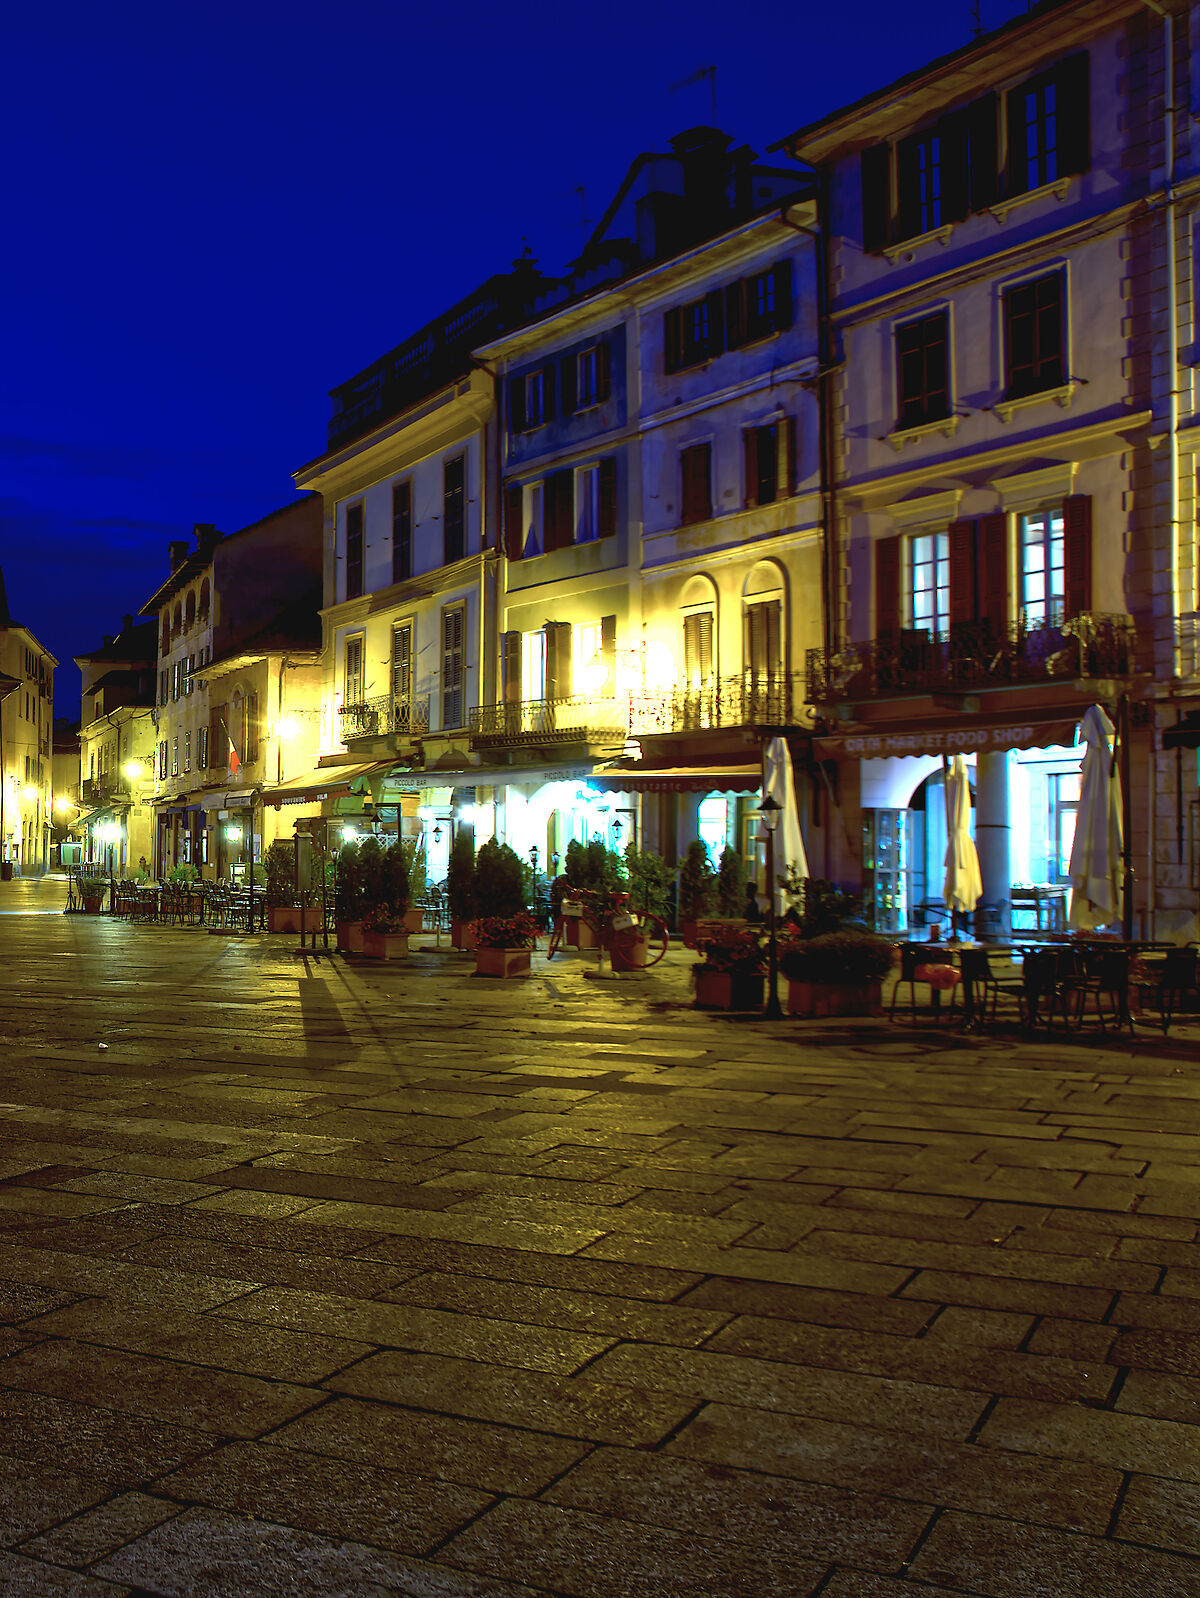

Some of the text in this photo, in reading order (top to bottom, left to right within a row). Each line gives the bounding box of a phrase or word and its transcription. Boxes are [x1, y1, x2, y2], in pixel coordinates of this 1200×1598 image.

[886, 734, 943, 750] MARKET
[947, 731, 987, 747] FOOD
[993, 727, 1034, 744] SHOP
